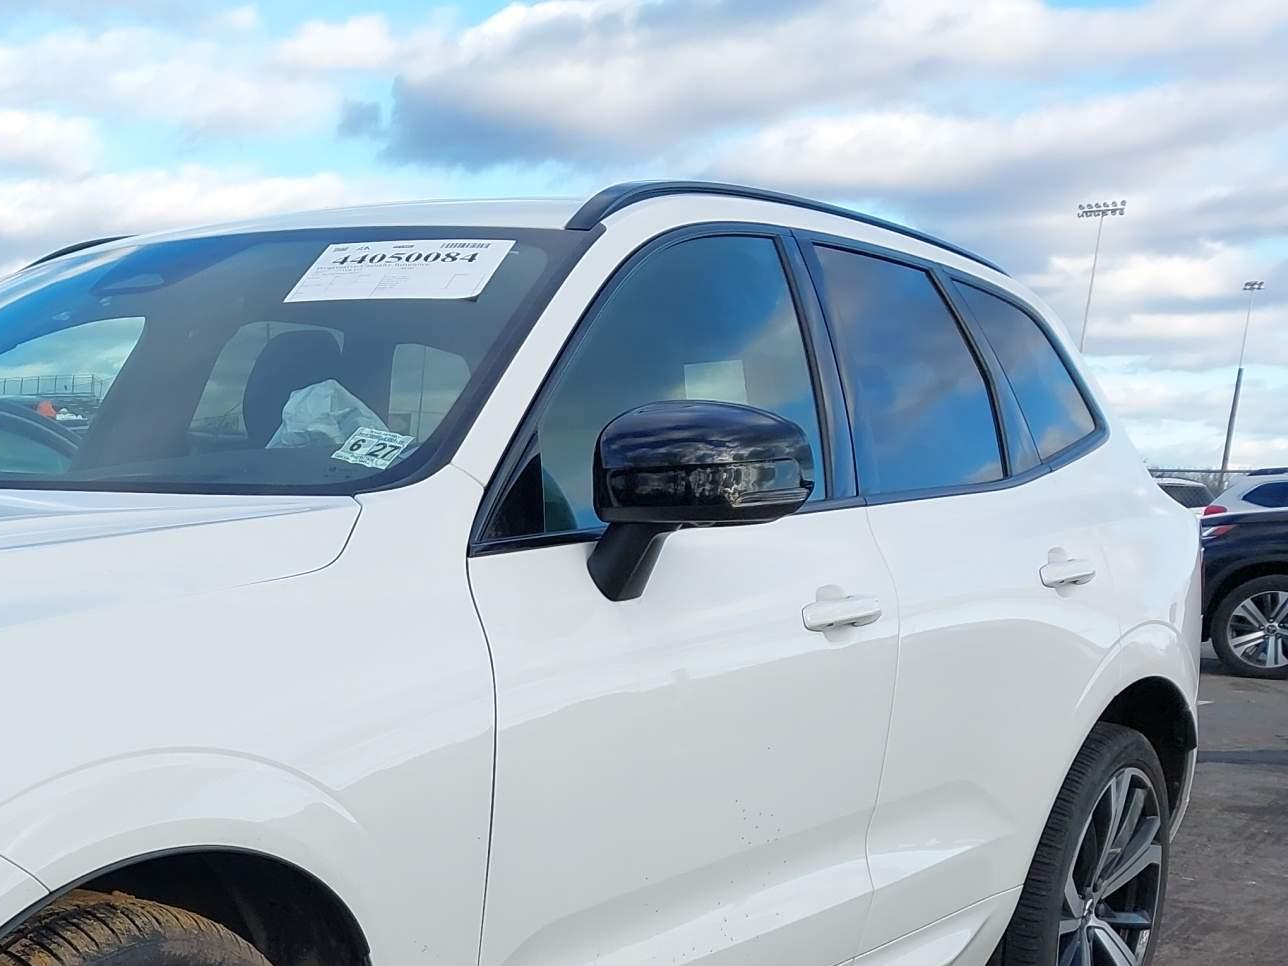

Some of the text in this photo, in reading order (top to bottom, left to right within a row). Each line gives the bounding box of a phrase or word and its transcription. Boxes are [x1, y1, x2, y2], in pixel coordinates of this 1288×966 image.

[333, 252, 480, 265] 44050084
[350, 439, 400, 459] 6 27
